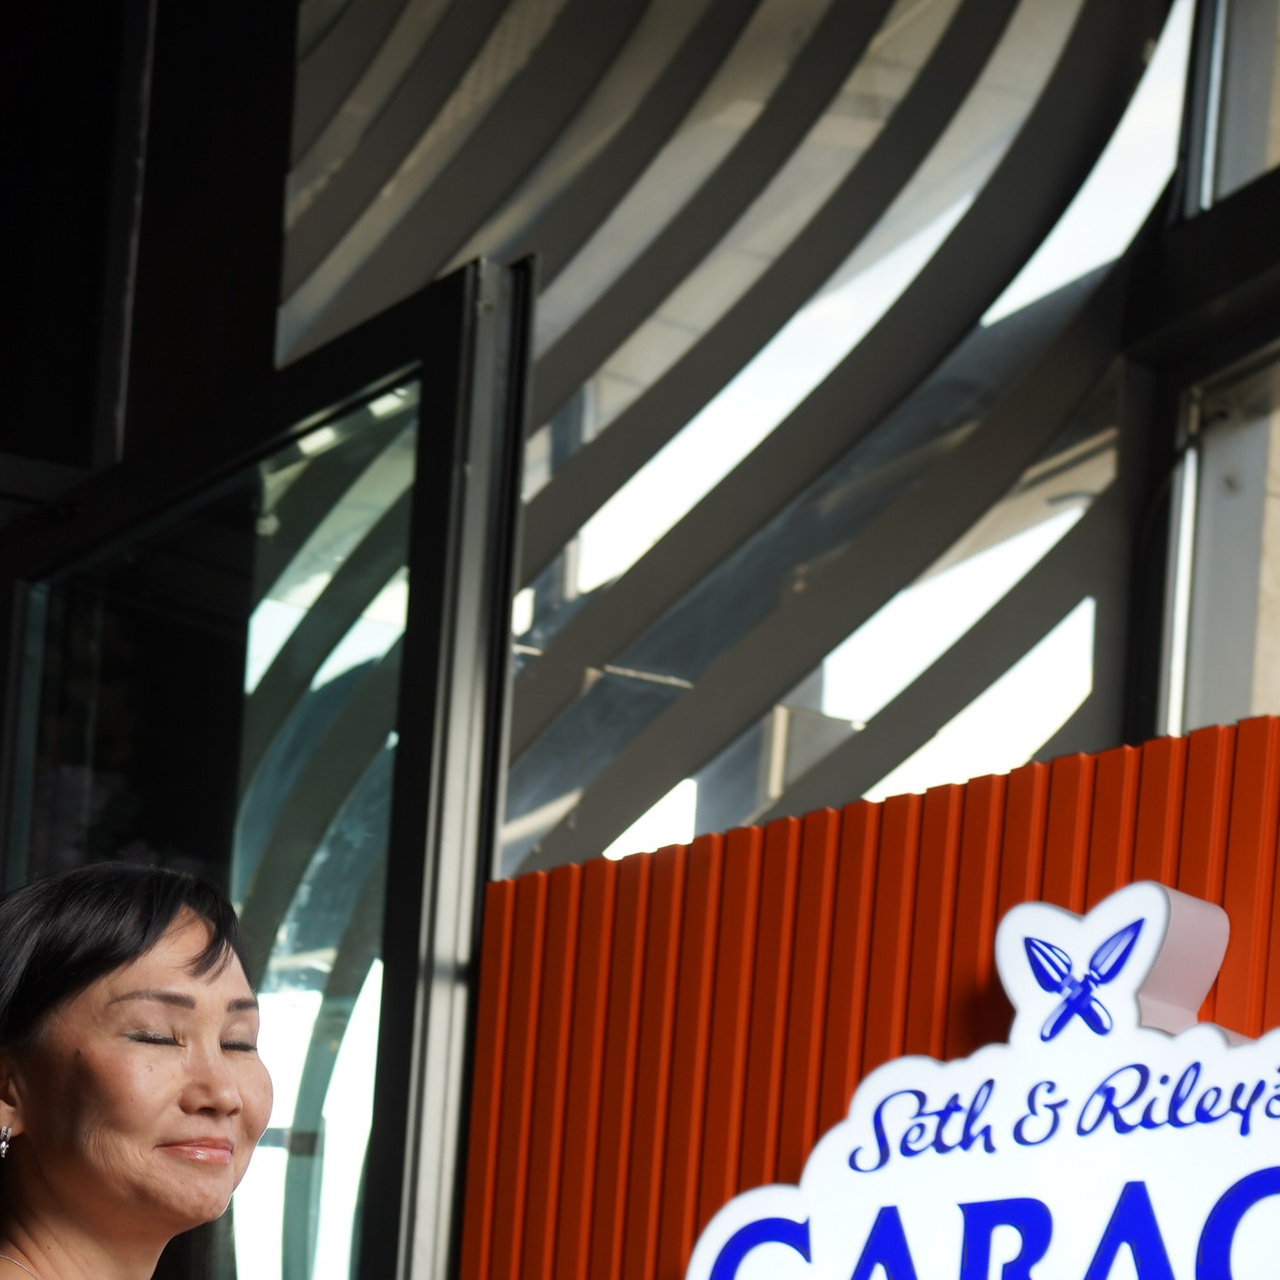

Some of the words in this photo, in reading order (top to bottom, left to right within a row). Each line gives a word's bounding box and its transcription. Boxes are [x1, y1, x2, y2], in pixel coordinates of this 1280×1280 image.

[848, 1078, 996, 1173] Seth
[1012, 1080, 1068, 1146] &
[1076, 1061, 1280, 1137] Riley
